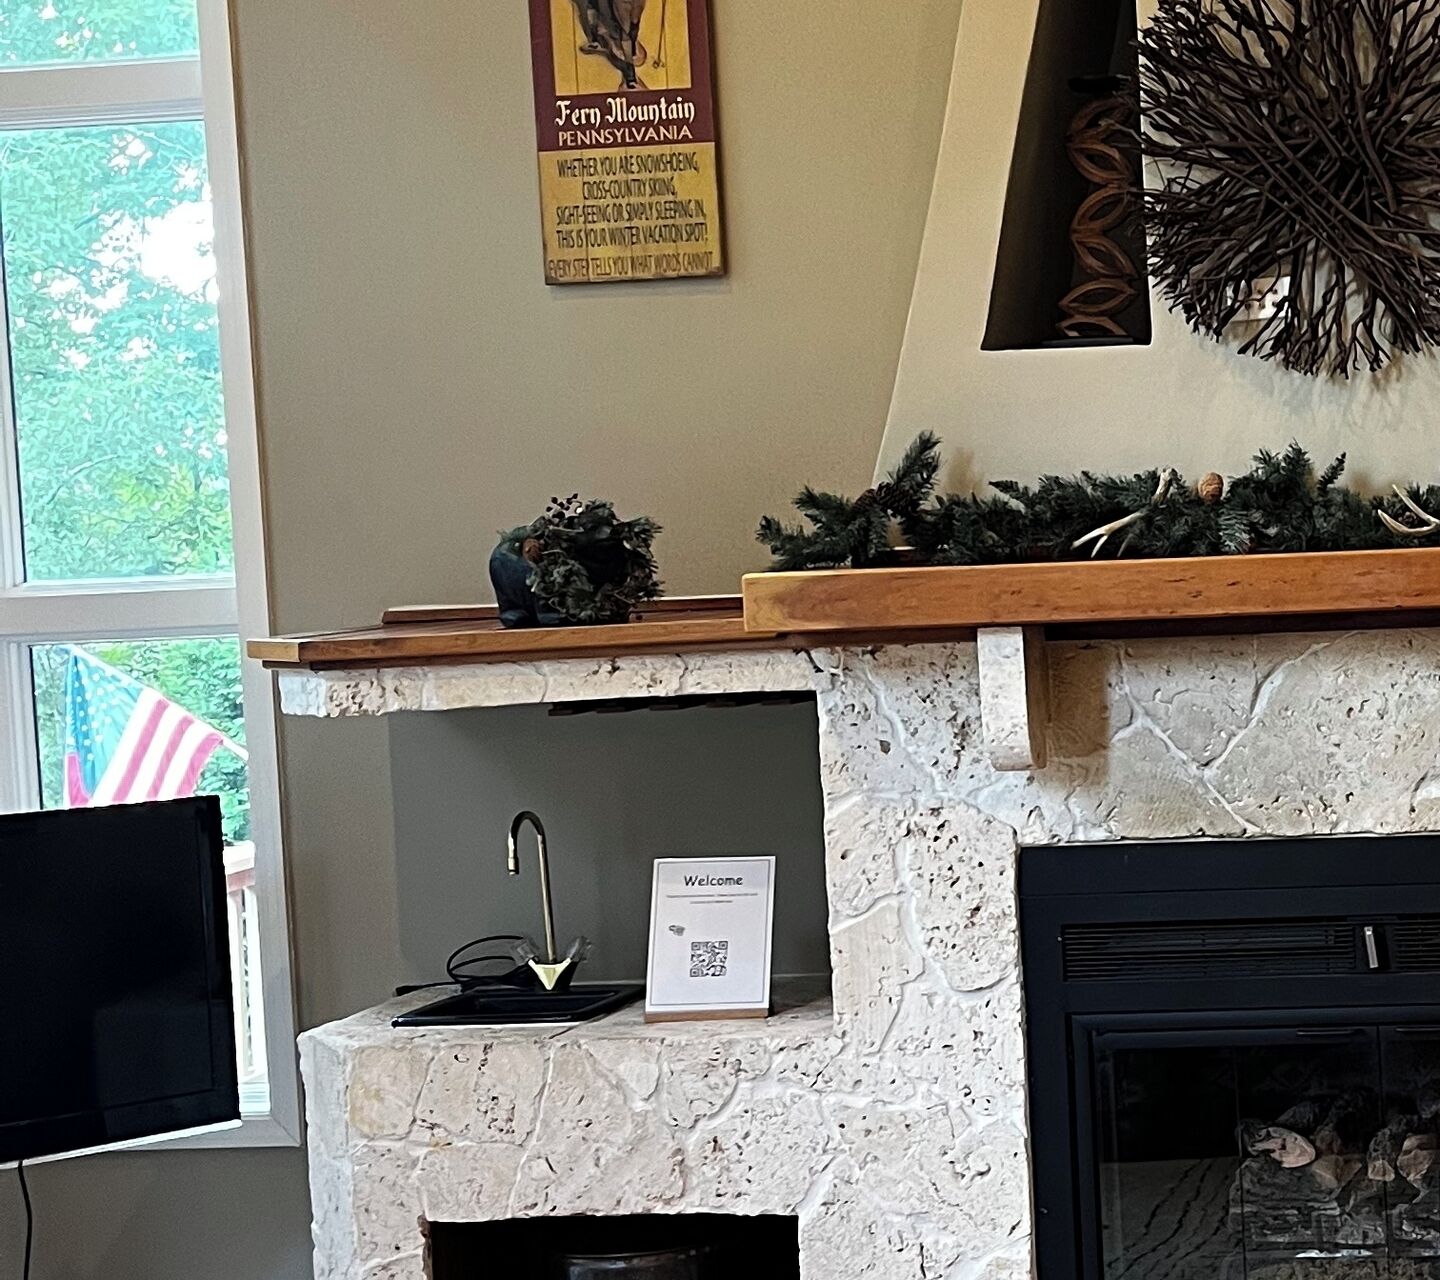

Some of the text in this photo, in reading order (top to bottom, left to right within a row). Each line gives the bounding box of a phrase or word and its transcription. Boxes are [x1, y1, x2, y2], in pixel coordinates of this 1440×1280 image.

[555, 96, 695, 129] Fern Mountain
[559, 125, 693, 146] PENNSYLVANIA
[557, 157, 599, 177] WHETHER
[600, 156, 617, 176] YOU
[619, 155, 635, 174] ARE
[582, 179, 647, 200] CROSS-COUNTRY
[612, 203, 624, 223] OR
[625, 201, 654, 222] SIMPLY
[655, 199, 694, 220] SLEEPING
[556, 228, 575, 248] THIS
[575, 228, 584, 248] IS
[585, 227, 608, 247] YOUR
[608, 225, 641, 246] WINTER
[641, 223, 684, 244] VACATION
[548, 259, 571, 278] EVERY
[590, 257, 612, 276] TELLS
[612, 256, 628, 276] YOU
[629, 254, 653, 275] WHAT
[683, 875, 744, 887] Welcome
